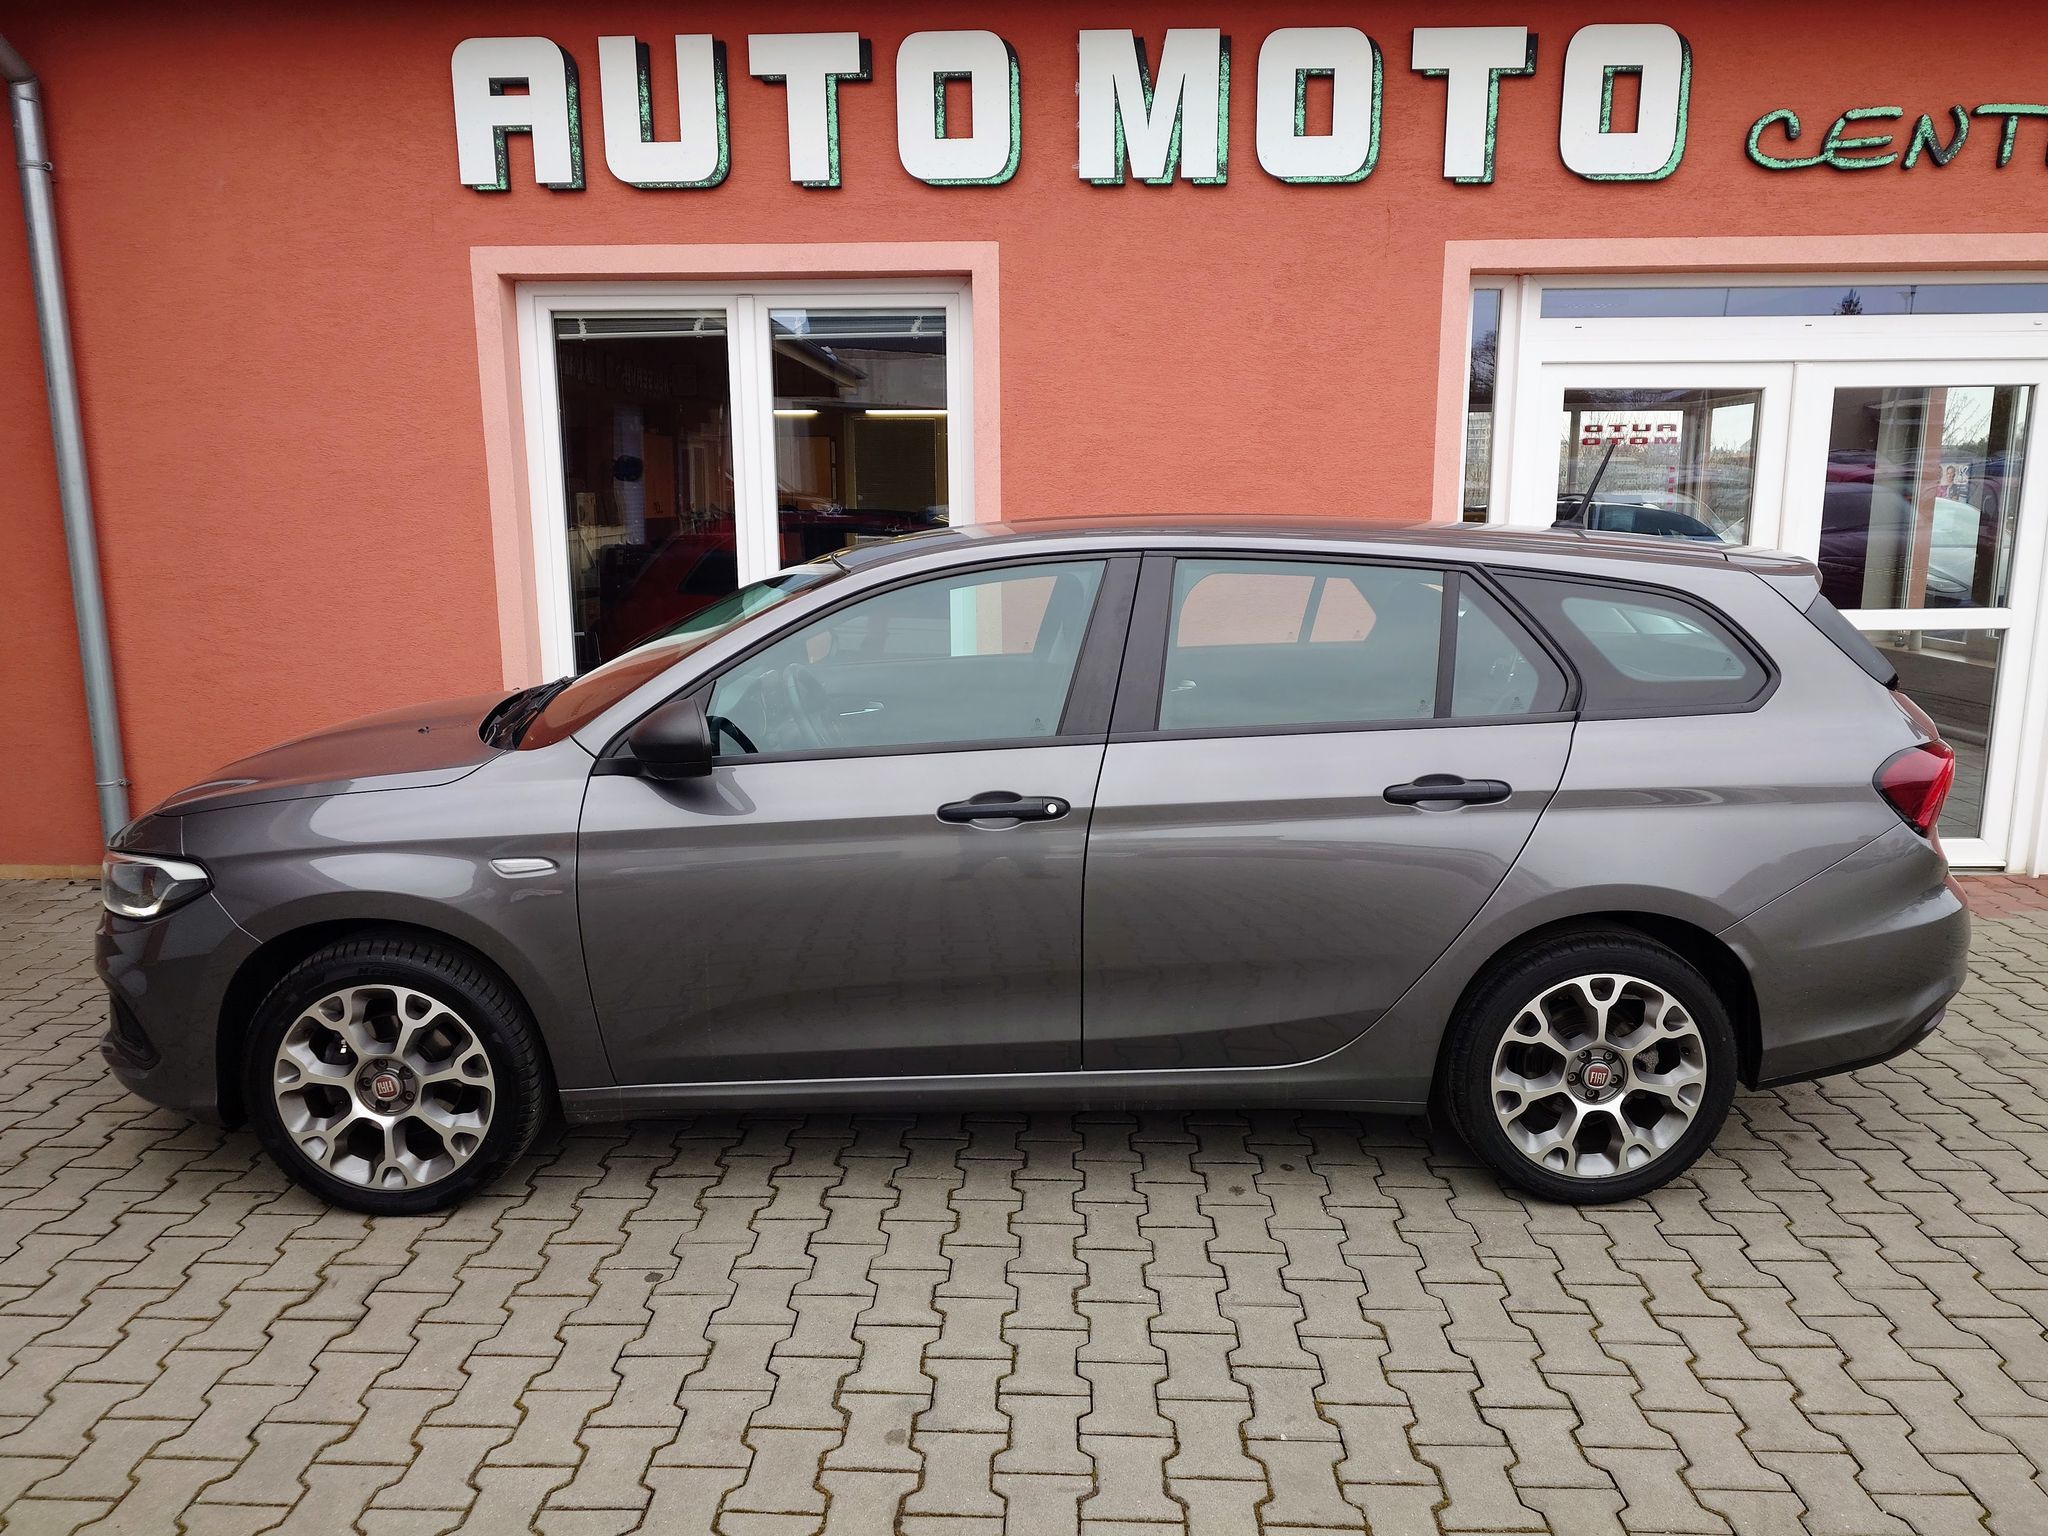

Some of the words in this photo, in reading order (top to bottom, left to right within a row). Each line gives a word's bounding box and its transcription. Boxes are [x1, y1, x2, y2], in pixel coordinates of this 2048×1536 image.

[451, 29, 1021, 190] AUTO
[1078, 23, 1692, 186] MOTO
[1745, 103, 2048, 170] CENT
[1590, 1071, 1607, 1084] FIAT
[377, 1080, 394, 1094] FIAT
